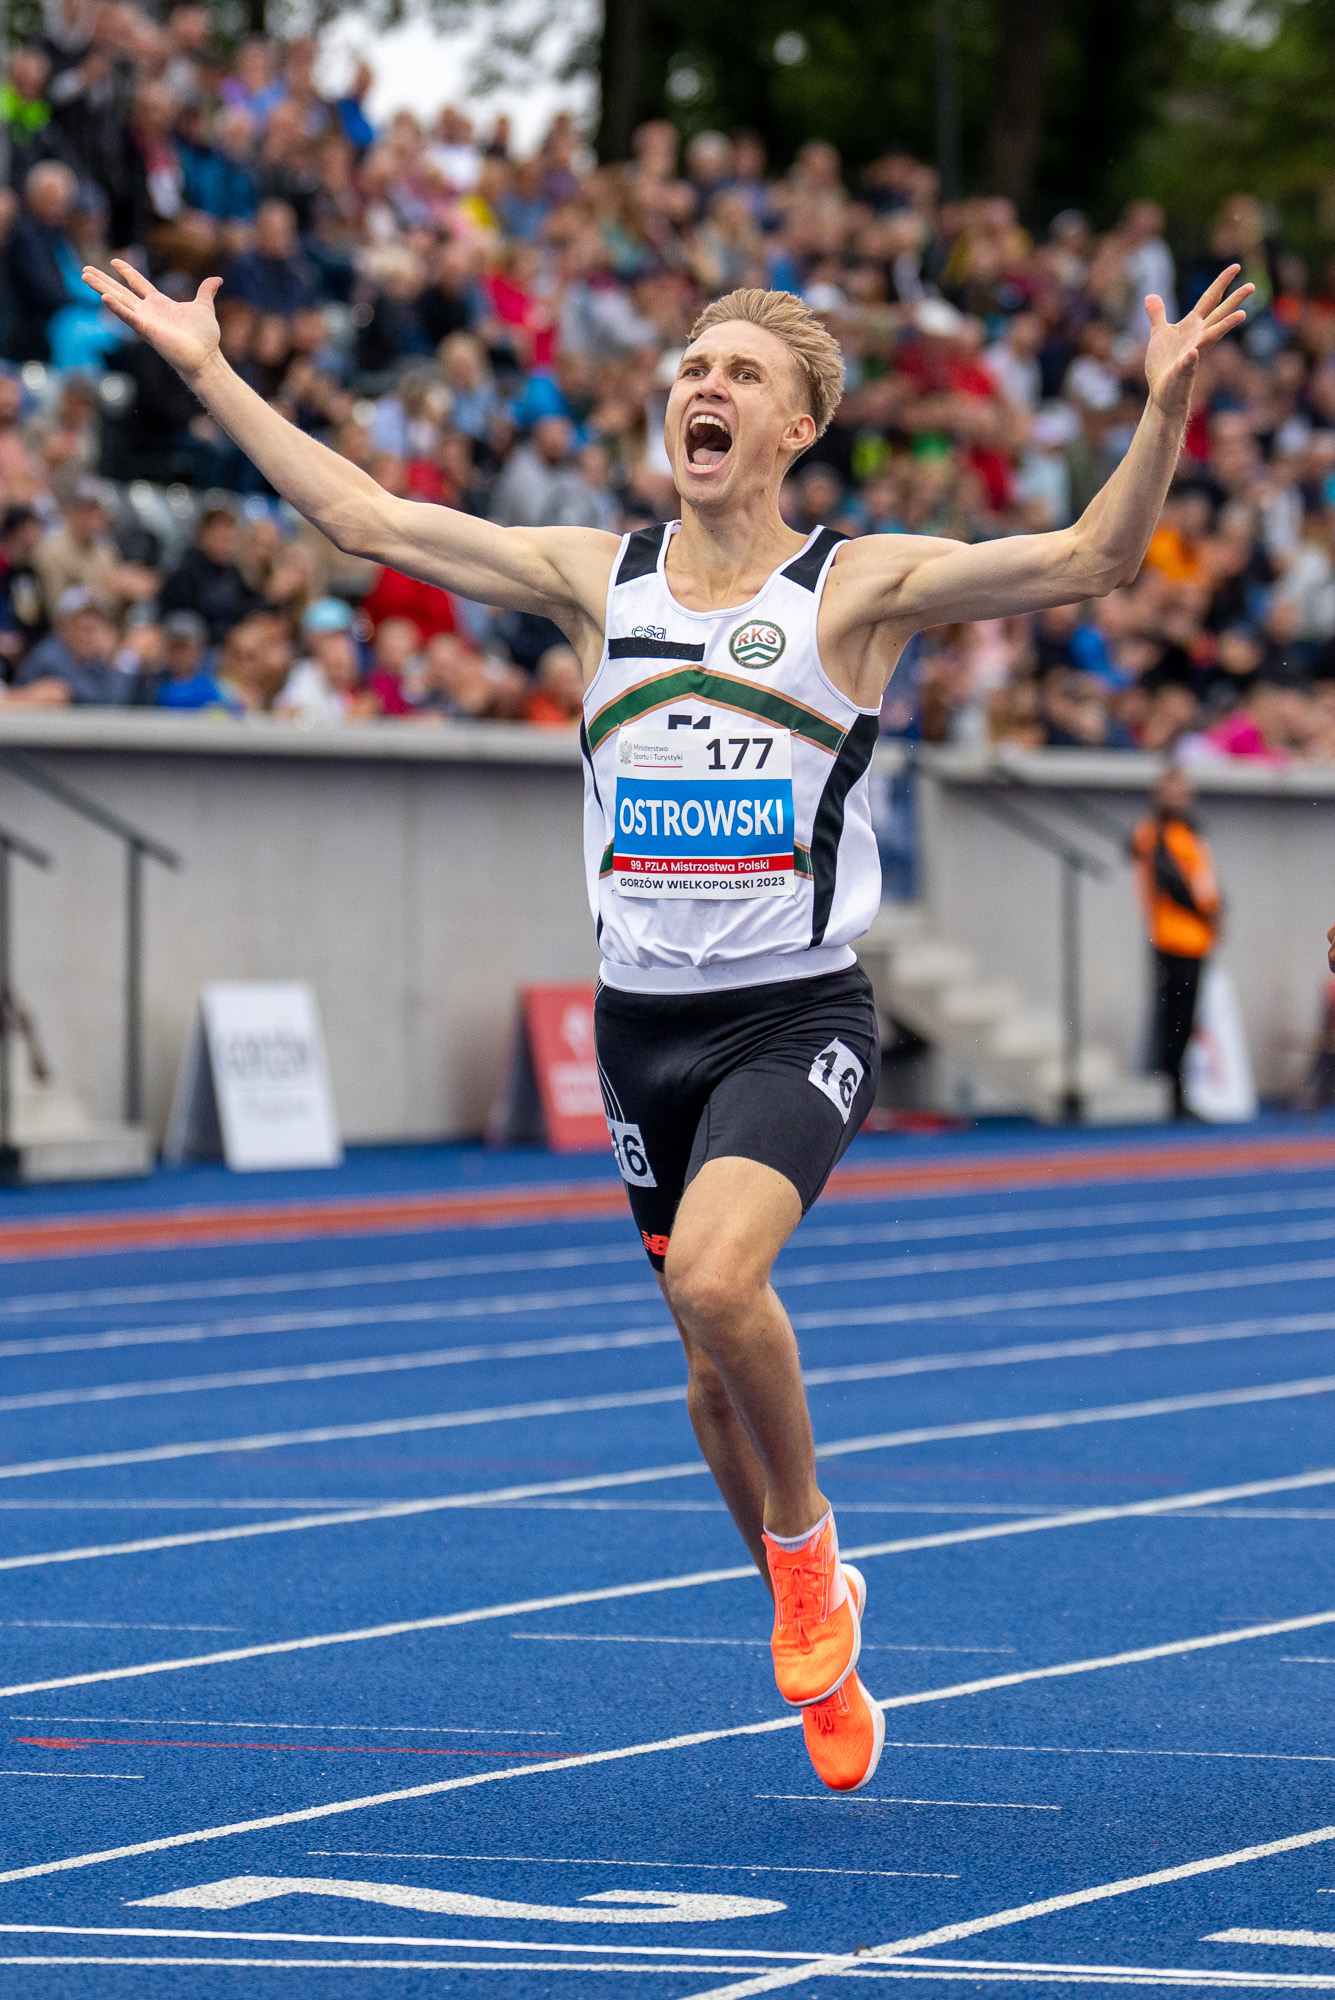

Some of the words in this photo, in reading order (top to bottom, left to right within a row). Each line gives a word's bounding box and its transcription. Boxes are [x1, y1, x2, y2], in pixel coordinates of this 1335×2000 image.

[737, 627, 777, 647] RKS
[633, 744, 669, 752] Ministerstwo
[633, 753, 650, 761] Sportu
[654, 753, 683, 762] Turystyki
[705, 738, 774, 770] 177
[619, 797, 784, 837] OSTROWSKI
[630, 860, 643, 871] 99.
[645, 862, 668, 872] PZLA
[670, 862, 735, 872] Mistrzostwa
[738, 859, 770, 871] Polski
[620, 877, 663, 889] GORZÓW
[667, 880, 754, 890] WIELKOPOLSKI
[756, 877, 785, 888] 2023
[817, 1050, 858, 1109] 16
[125, 1876, 787, 1923] 2
